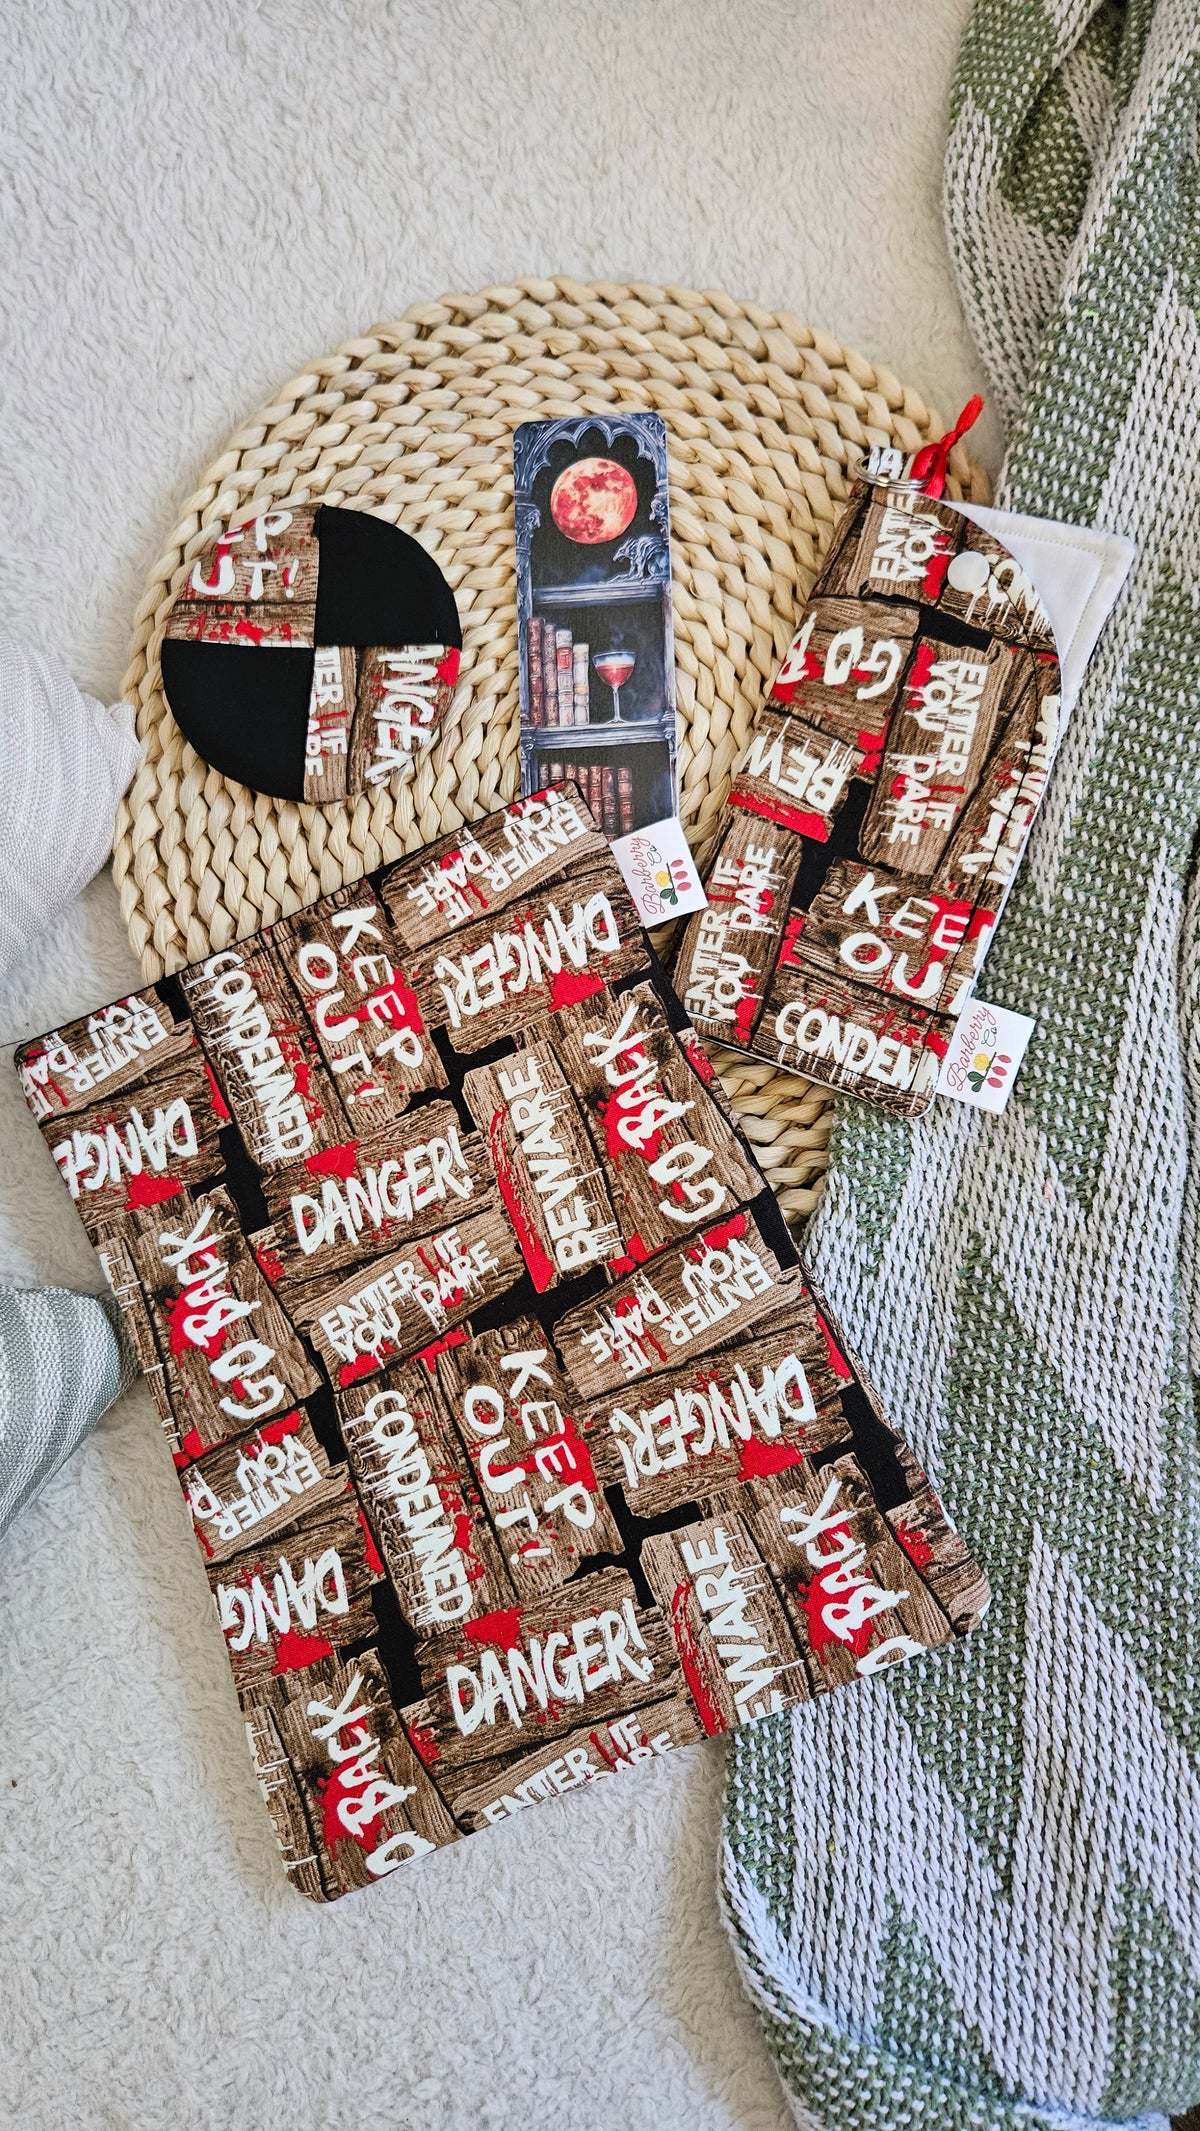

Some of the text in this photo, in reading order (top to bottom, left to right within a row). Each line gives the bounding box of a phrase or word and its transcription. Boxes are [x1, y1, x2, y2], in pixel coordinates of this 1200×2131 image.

[823, 626, 903, 700] GO
[882, 660, 960, 846] YOU DARE
[924, 660, 989, 832] ENTER IF
[407, 789, 577, 917] YOU DARE
[444, 811, 589, 929] ENTER IF
[630, 837, 666, 914] Barberry
[332, 906, 423, 1069] KEEP
[433, 892, 621, 1028] DANGER!
[684, 856, 739, 1022] ENTER IF
[708, 844, 778, 1020] YOU DARE
[65, 1012, 170, 1093] ENTER
[88, 996, 156, 1048] YOU
[201, 951, 314, 1163] CONDEMNED
[299, 943, 385, 1105] OUT!
[947, 1006, 997, 1092] Barberry
[499, 1055, 608, 1270] BEWARE
[583, 1001, 728, 1224] GO BACK
[290, 1125, 475, 1255] DANGER!
[158, 1204, 286, 1420] GO BACK
[318, 1226, 462, 1337] ENTER IF
[331, 1239, 499, 1366] YOU DARE
[579, 1236, 760, 1366] YOU DARE
[621, 1258, 776, 1380] ENTER IF
[236, 1433, 311, 1494] YOU
[464, 1385, 551, 1565] OUT!
[501, 1349, 596, 1530] KEEP
[609, 1353, 818, 1489] DANGER!
[209, 1456, 324, 1541] ENTER
[362, 1390, 474, 1624] CONDEMNED
[780, 1475, 911, 1643] BACK
[446, 1598, 655, 1738] DANGER!
[306, 1669, 418, 1838] BACK
[481, 1713, 641, 1824] ENTER IF
